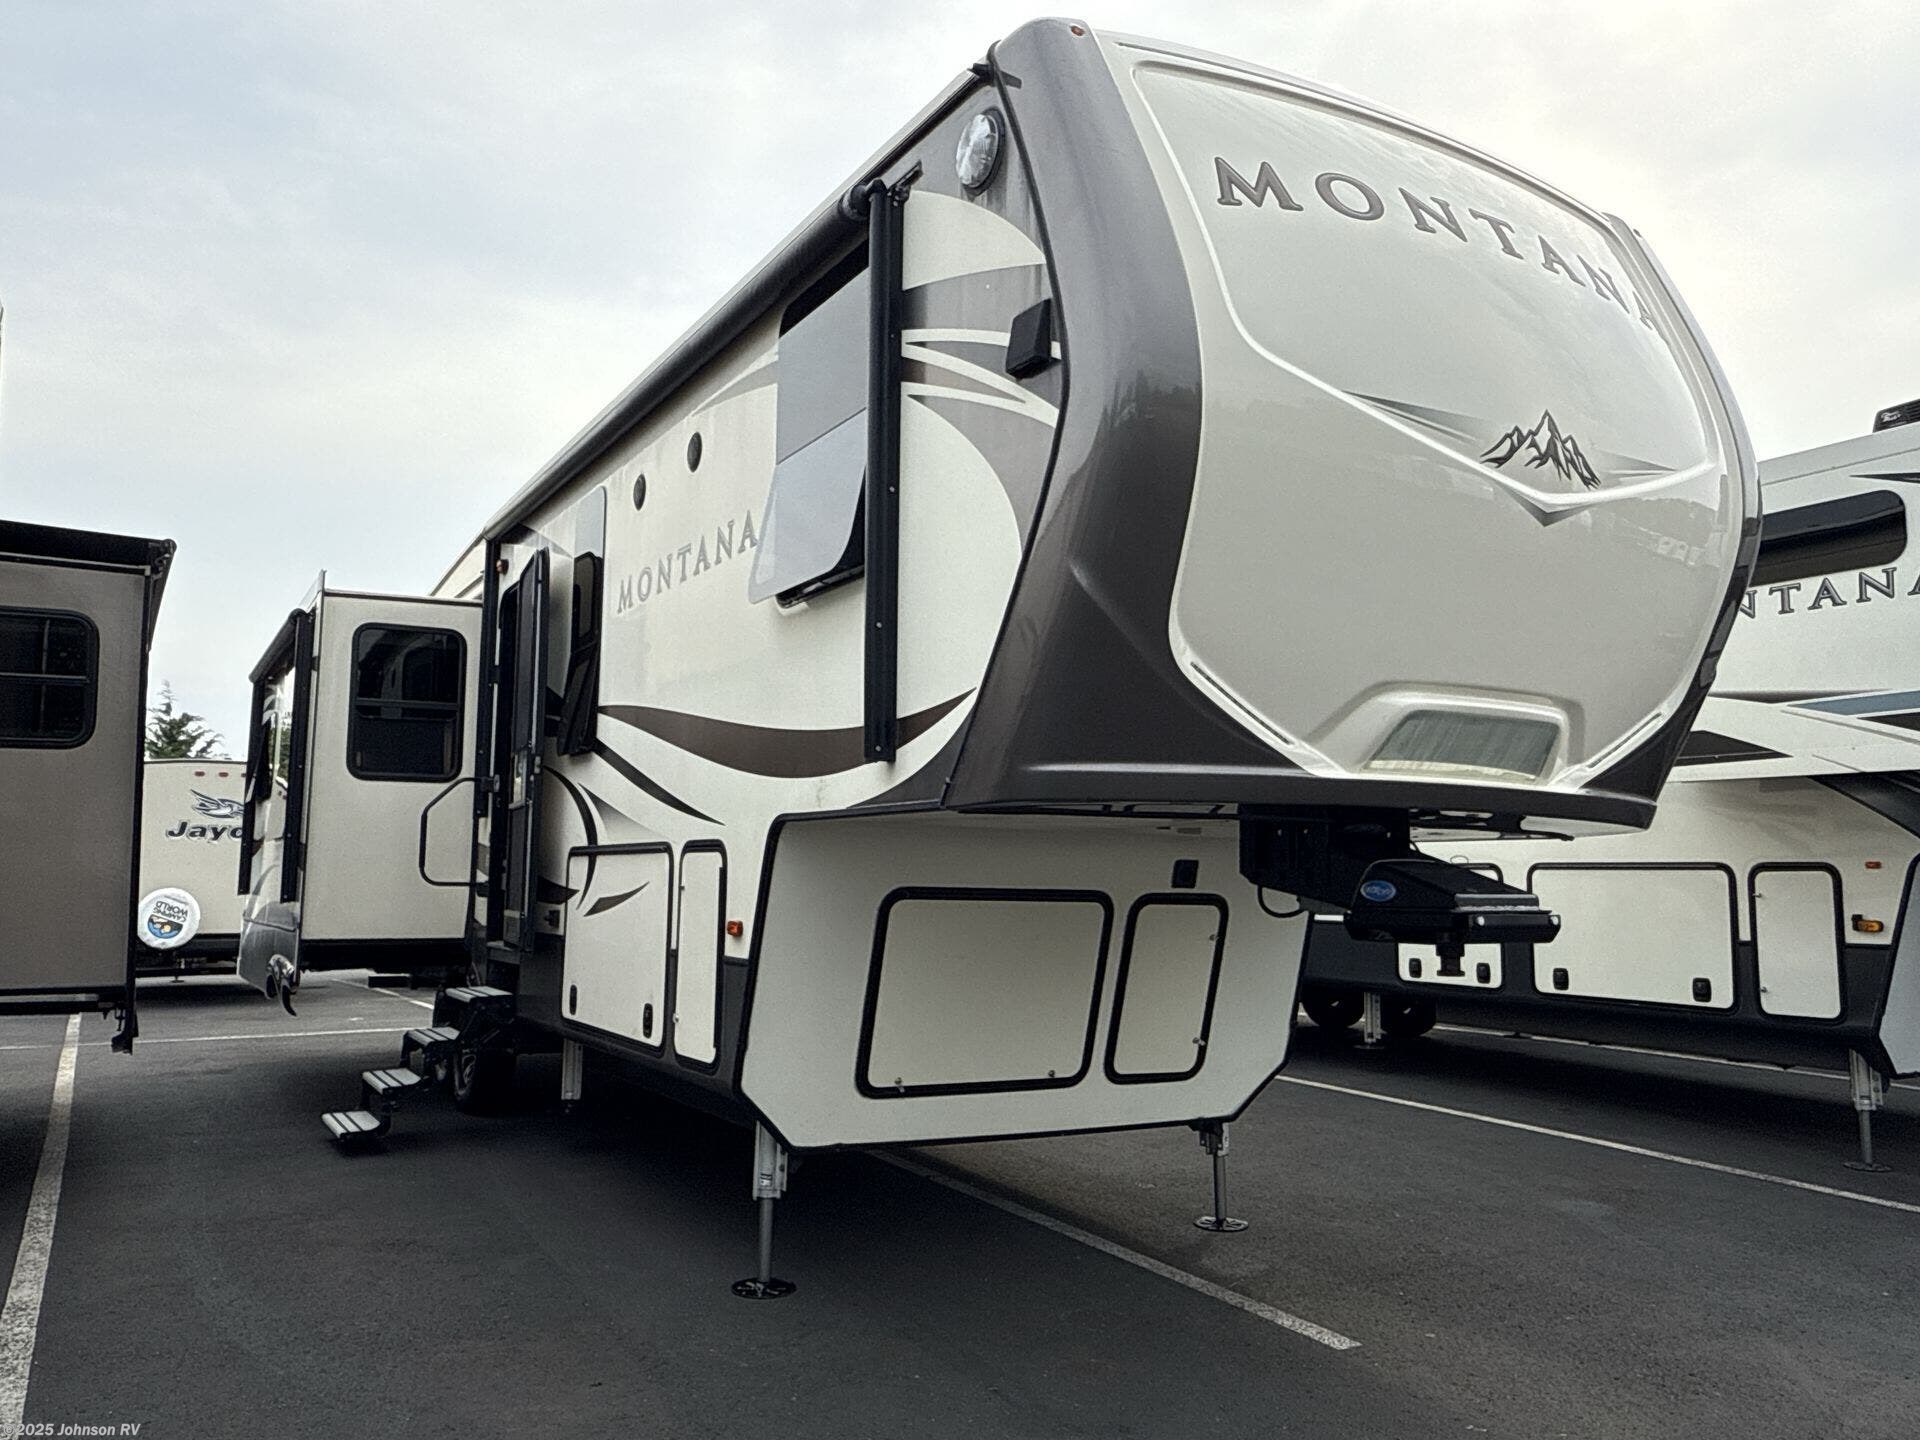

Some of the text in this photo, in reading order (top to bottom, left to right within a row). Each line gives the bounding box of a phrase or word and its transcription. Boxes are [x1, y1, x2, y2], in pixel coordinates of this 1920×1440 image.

[1213, 156, 1660, 337] MONTANA
[617, 510, 759, 614] MONTANA
[155, 900, 189, 917] WORLD
